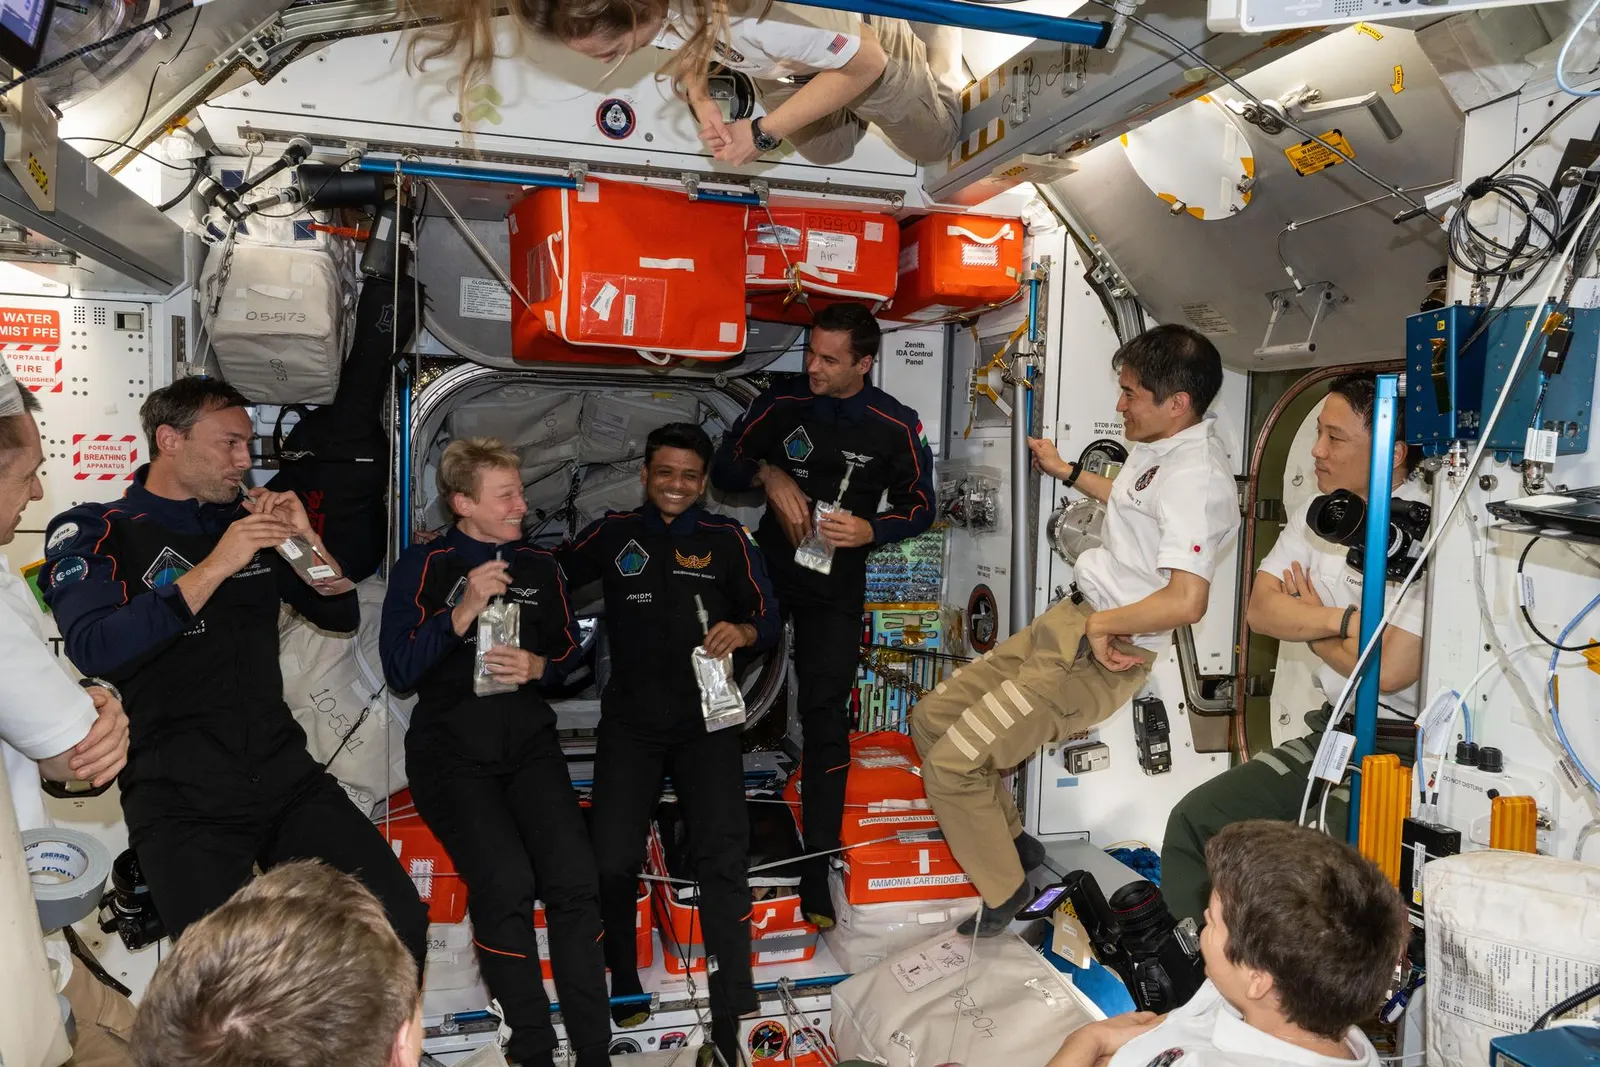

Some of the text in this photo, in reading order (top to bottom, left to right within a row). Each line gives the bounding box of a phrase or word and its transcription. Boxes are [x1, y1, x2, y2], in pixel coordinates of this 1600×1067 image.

[3, 312, 52, 325] WATER
[0, 326, 58, 338] MIST PFE
[905, 341, 925, 349] Zenith
[905, 358, 923, 366] Panel
[16, 364, 43, 373] FIRE
[65, 564, 82, 576] esa
[626, 592, 653, 600] AXIOM
[1451, 778, 1461, 786] NOT
[1461, 781, 1484, 793] DISTURB
[861, 817, 900, 825] AMMONIA
[870, 879, 911, 888] AMMONIA
[913, 876, 960, 885] CARTRIDGE
[1140, 981, 1150, 1006] Canon
